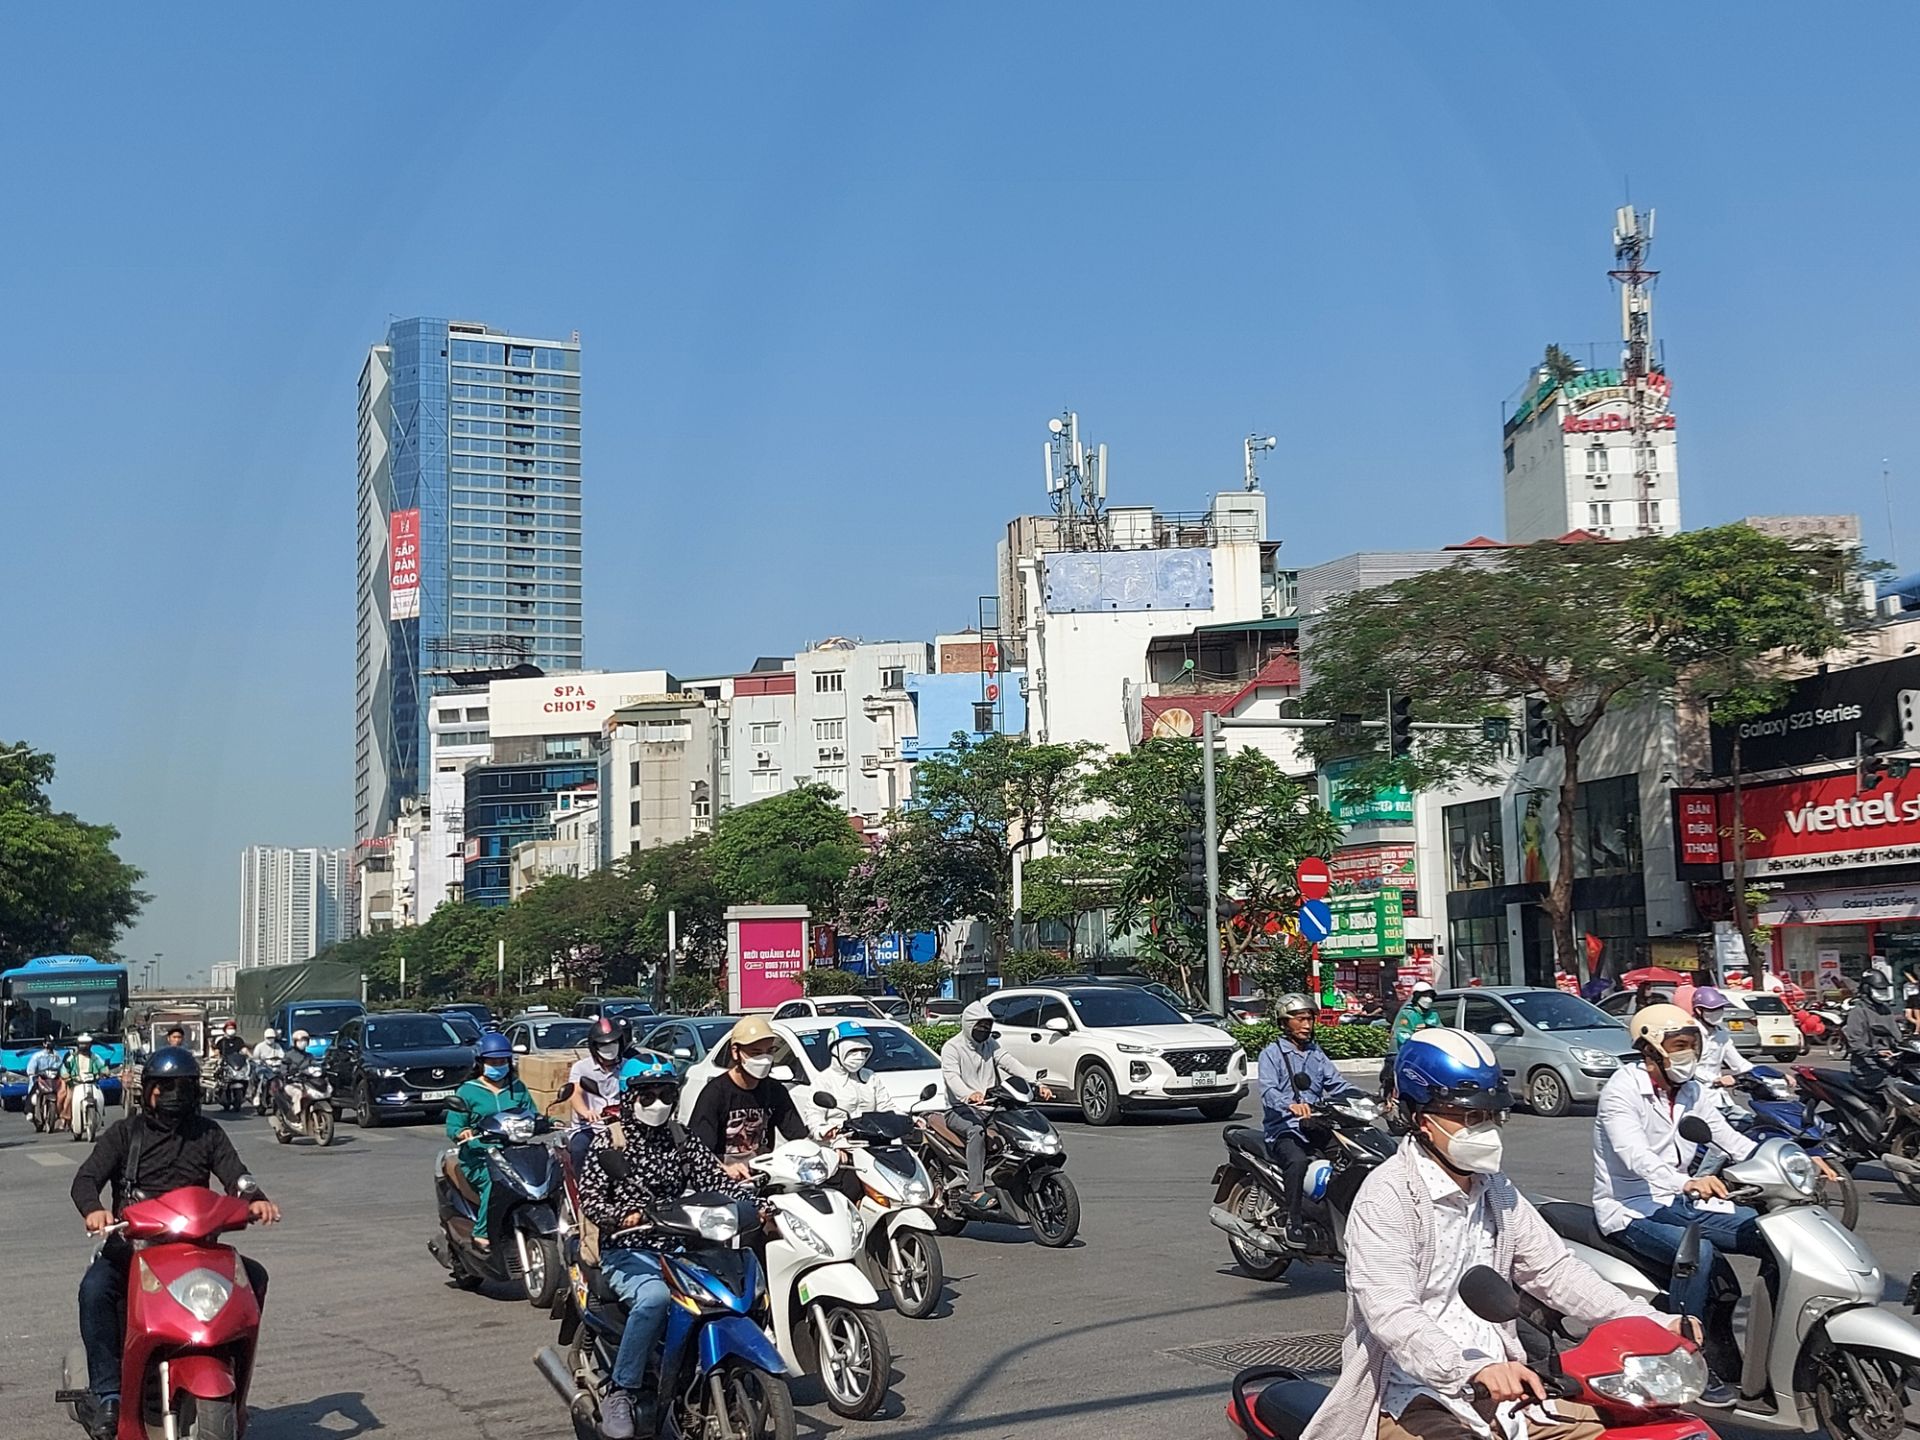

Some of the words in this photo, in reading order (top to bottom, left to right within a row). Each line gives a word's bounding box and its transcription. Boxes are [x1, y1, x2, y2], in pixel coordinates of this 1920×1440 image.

[395, 541, 415, 557] SẮP
[394, 558, 415, 572] BÀN
[392, 573, 417, 586] GIAO
[554, 685, 585, 697] SPA
[543, 700, 596, 713] CHOI'S
[1739, 718, 1788, 738] Galaxy
[1790, 711, 1813, 730] S23
[1815, 703, 1863, 725] Series
[1687, 800, 1711, 814] BÁN
[1784, 791, 1901, 834] viettel
[1687, 820, 1713, 836] ĐIỆN
[1685, 843, 1719, 856] THOẠI
